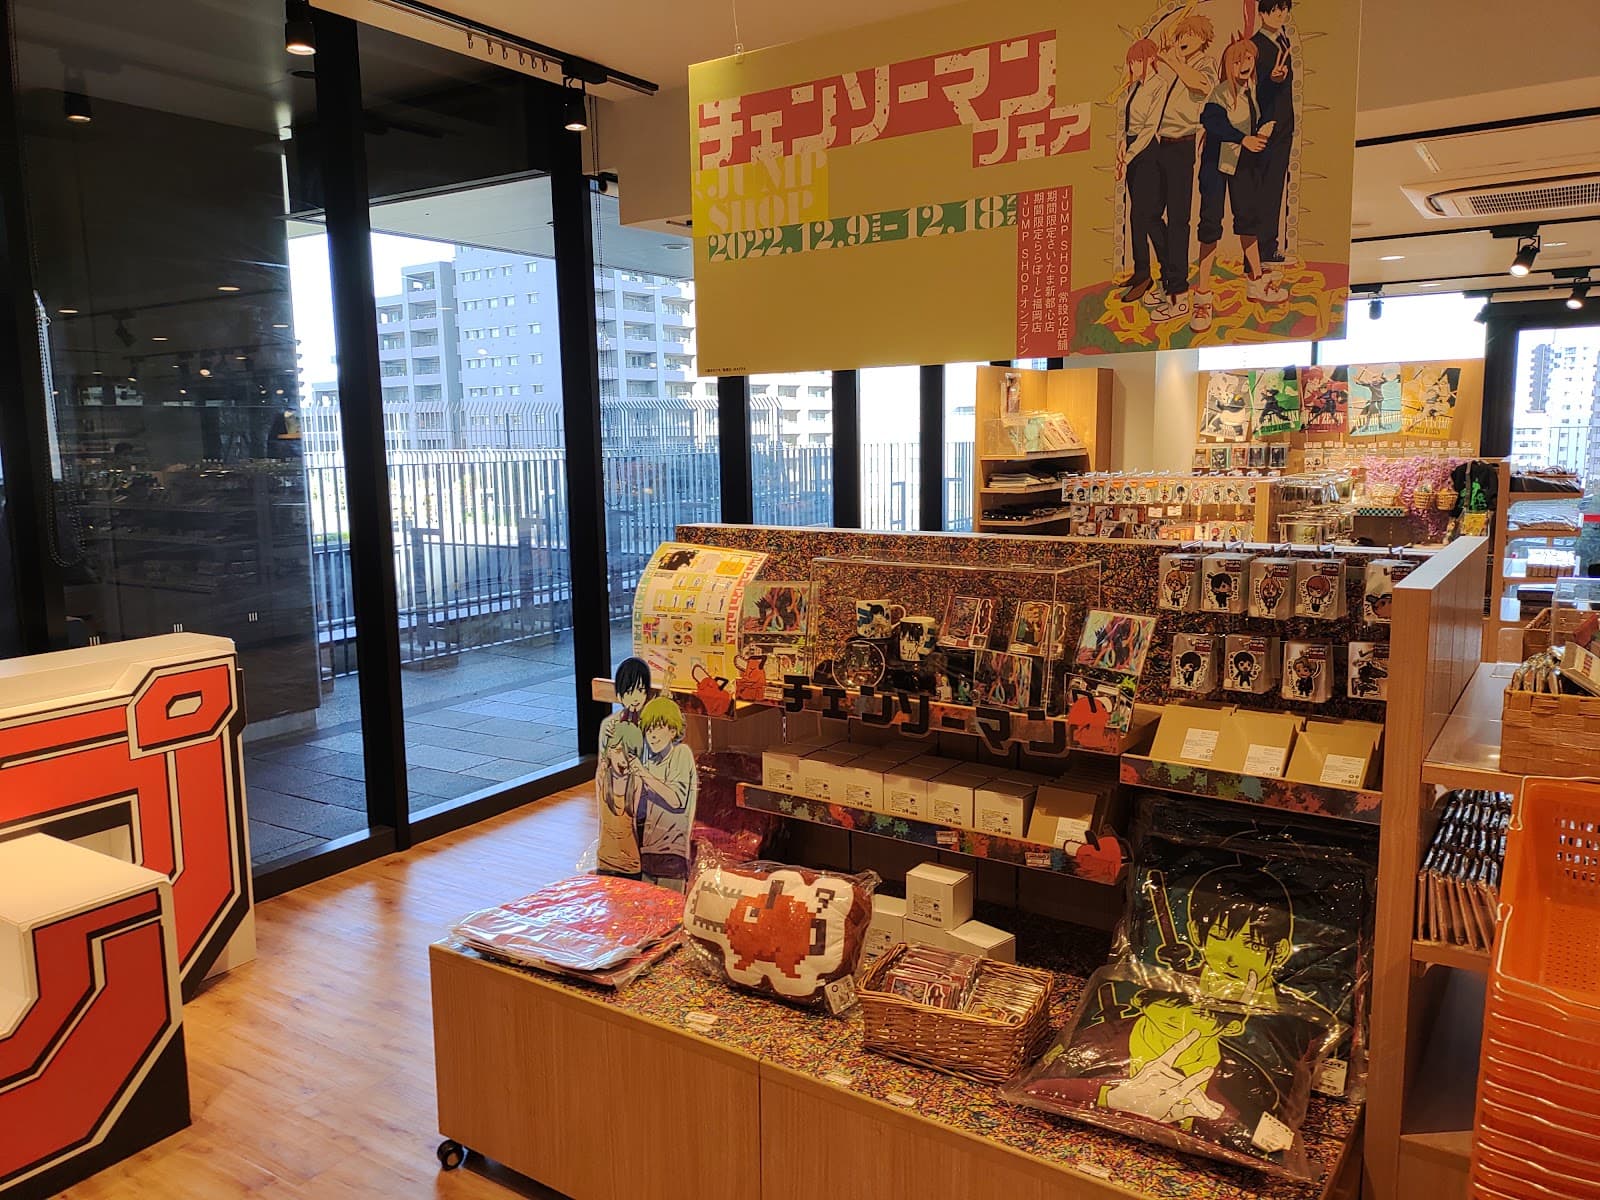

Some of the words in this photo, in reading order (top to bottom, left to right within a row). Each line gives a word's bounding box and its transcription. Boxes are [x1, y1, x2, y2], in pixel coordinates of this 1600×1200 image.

[699, 39, 1056, 170] チェンソーマン
[973, 102, 1091, 166] フェア
[706, 150, 828, 199] JUMP
[708, 191, 814, 234] SHOP
[1021, 194, 1031, 242] JUMP
[1060, 189, 1070, 235] JUMP
[1020, 248, 1030, 295] SHOP
[1044, 189, 1058, 333] 期間限定さいたま新都心店
[1059, 240, 1069, 286] SHOP
[1019, 298, 1030, 355] オンライン
[782, 674, 1070, 757] チェンソーマン
